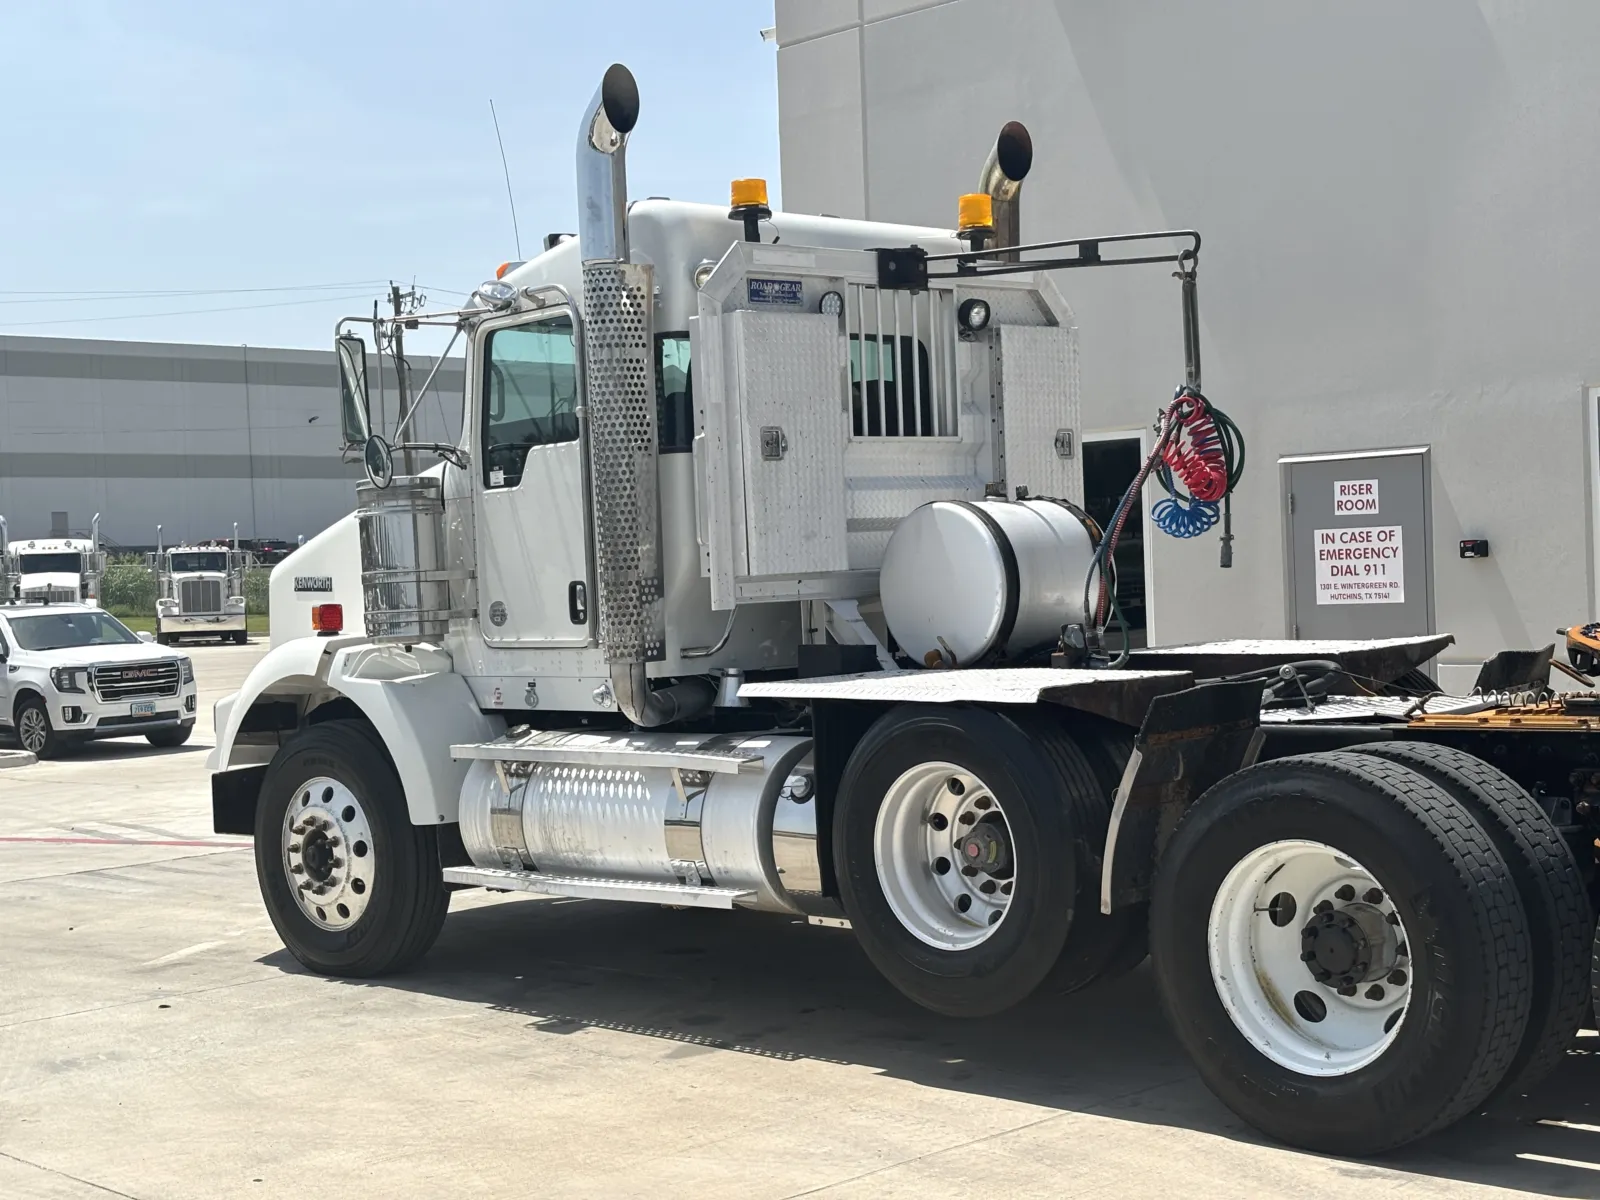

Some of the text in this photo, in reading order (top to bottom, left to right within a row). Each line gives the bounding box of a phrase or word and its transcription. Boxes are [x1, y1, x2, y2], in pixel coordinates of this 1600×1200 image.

[780, 282, 802, 292] GEAR
[1340, 483, 1373, 496] RISER
[1336, 499, 1377, 511] ROOM
[1321, 530, 1395, 544] IN CASE OF
[1319, 546, 1399, 561] EMERGENCY
[1330, 564, 1386, 577] DIAL 911
[294, 576, 333, 589] KENWORTH
[1341, 582, 1388, 590] WINTERGREEN
[122, 669, 158, 679] GMC
